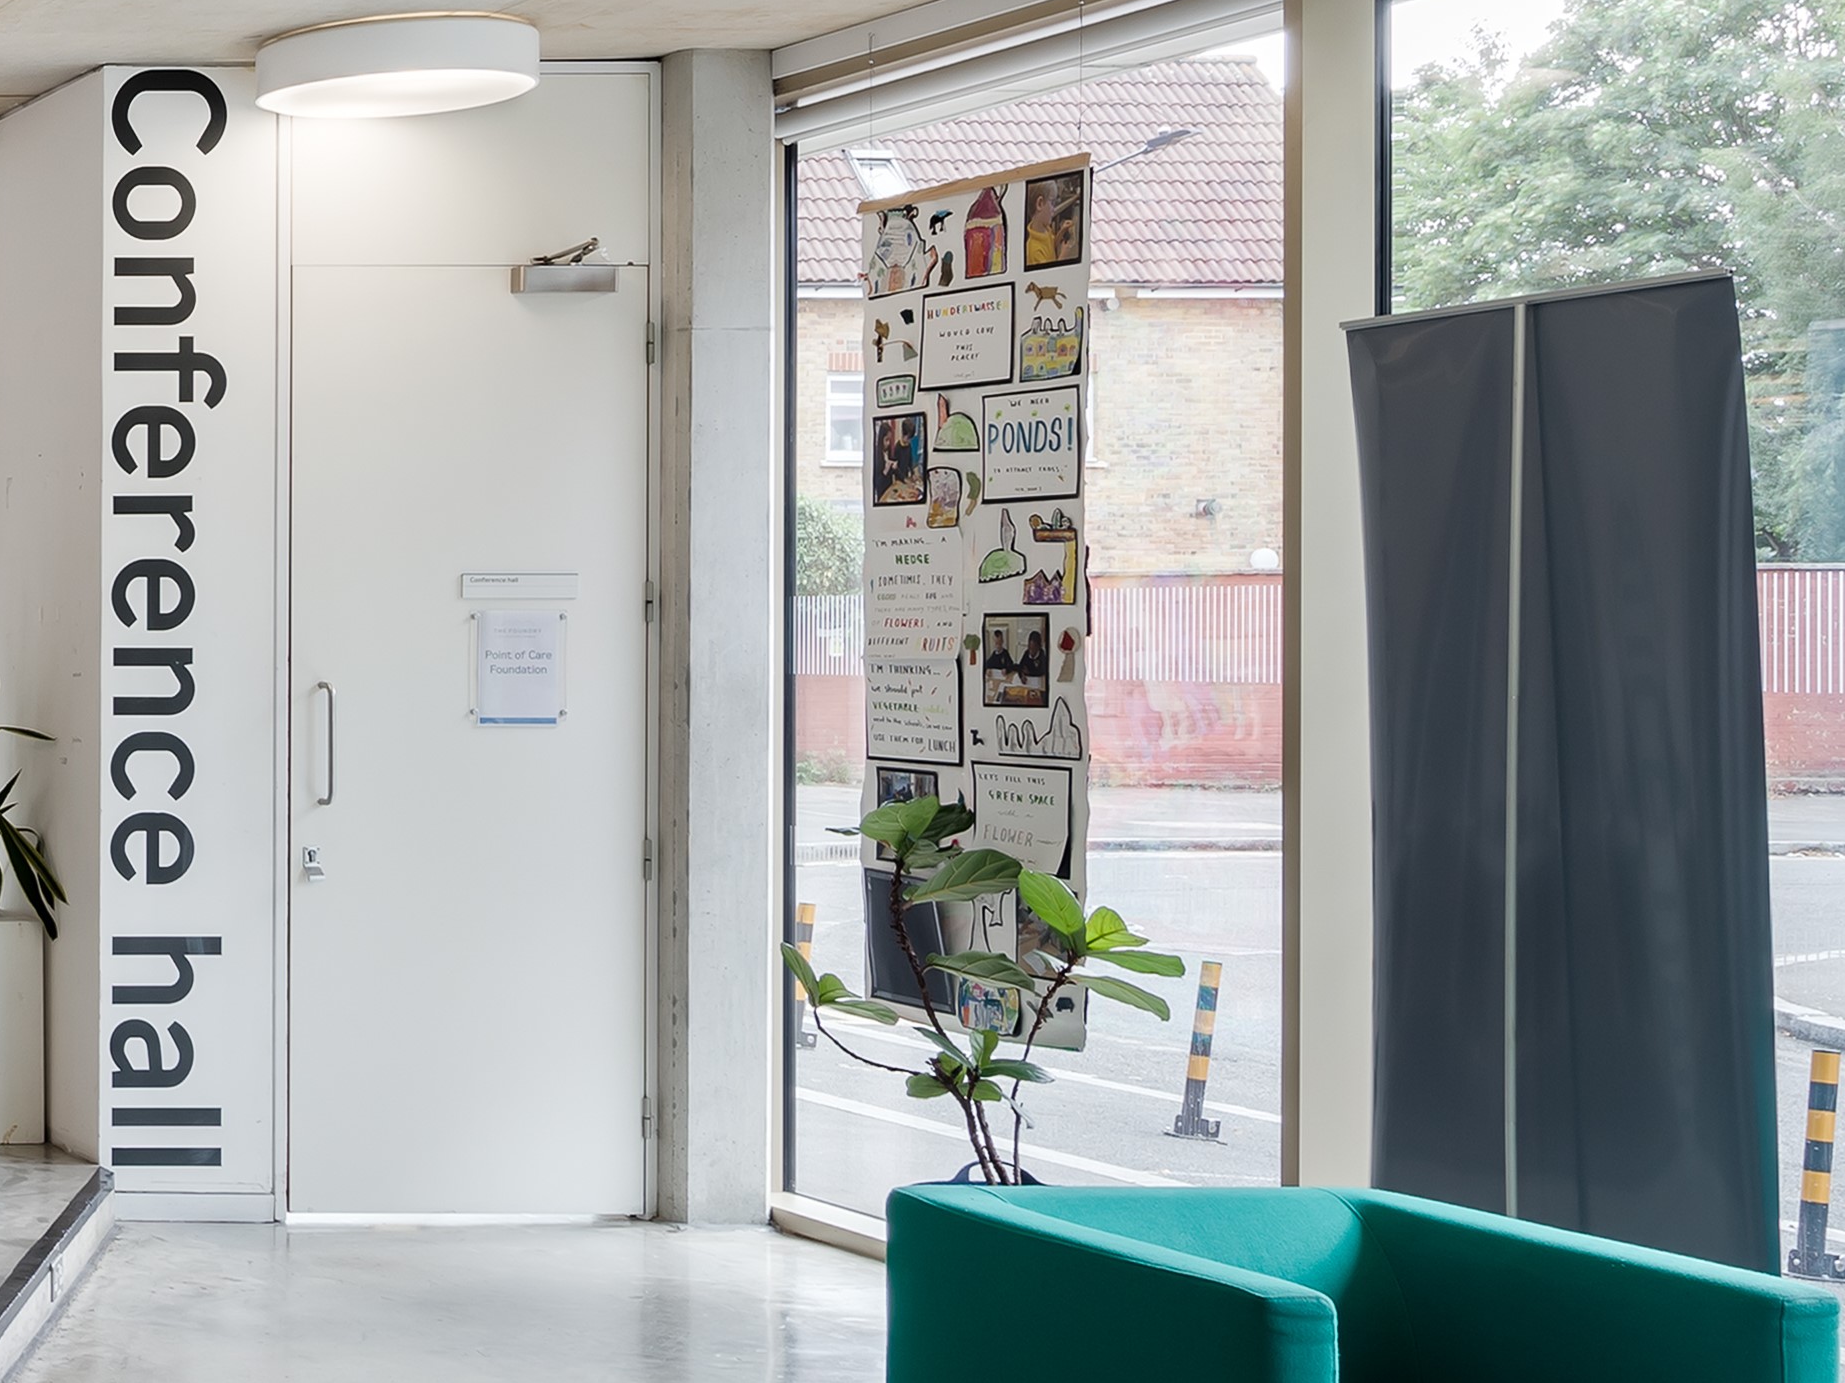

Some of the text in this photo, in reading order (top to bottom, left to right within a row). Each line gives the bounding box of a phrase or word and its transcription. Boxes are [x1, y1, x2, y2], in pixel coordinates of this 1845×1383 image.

[939, 326, 994, 337] WOULD LOVE
[988, 417, 1072, 454] PONDS!
[895, 554, 930, 565] HEDGE
[931, 575, 953, 586] THEY
[110, 68, 229, 1167] Conference hall
[485, 650, 552, 660] Point of Care
[489, 665, 548, 674] Foundation
[872, 701, 918, 713] VEGETABLE
[873, 733, 885, 741] USE
[890, 735, 909, 743] THEM
[911, 737, 924, 745] FOR
[1005, 775, 1021, 783] FILL
[1027, 777, 1046, 786] THIS
[988, 789, 1055, 806] GREEN SPACE
[983, 823, 1034, 847] FLOWER
